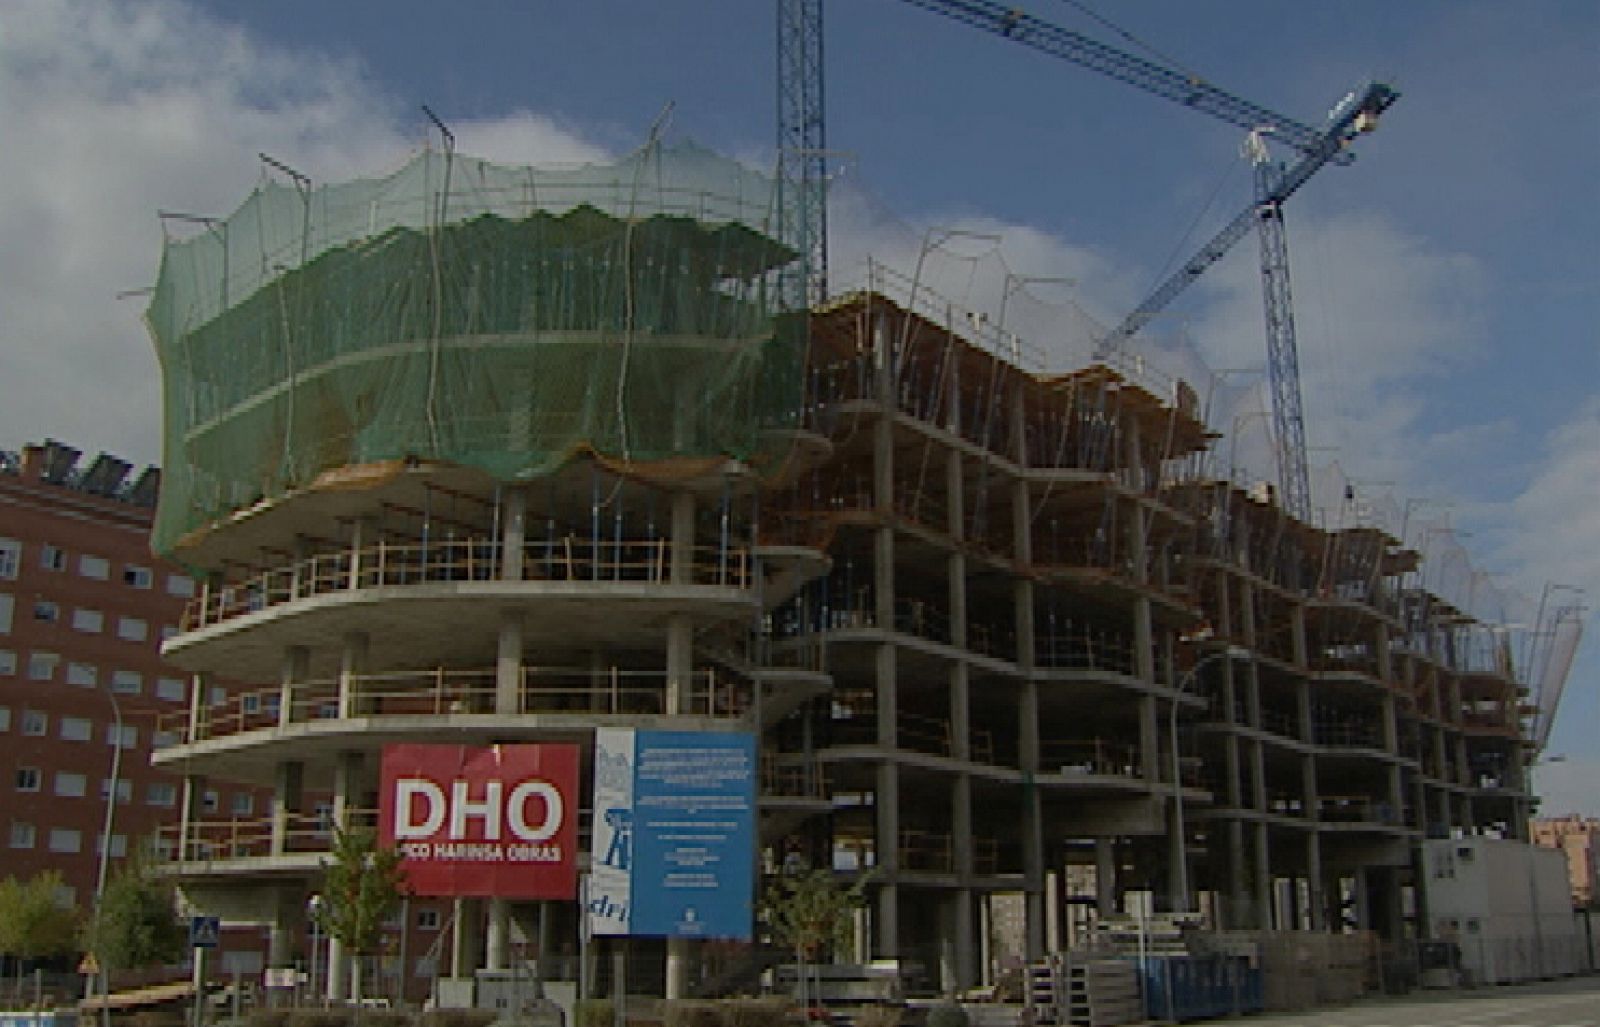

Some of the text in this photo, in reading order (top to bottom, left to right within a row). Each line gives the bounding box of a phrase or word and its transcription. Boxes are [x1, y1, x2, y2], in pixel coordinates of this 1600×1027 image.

[394, 778, 564, 841] DHO
[434, 843, 504, 862] HARINSA
[508, 843, 562, 862] OBRAS
